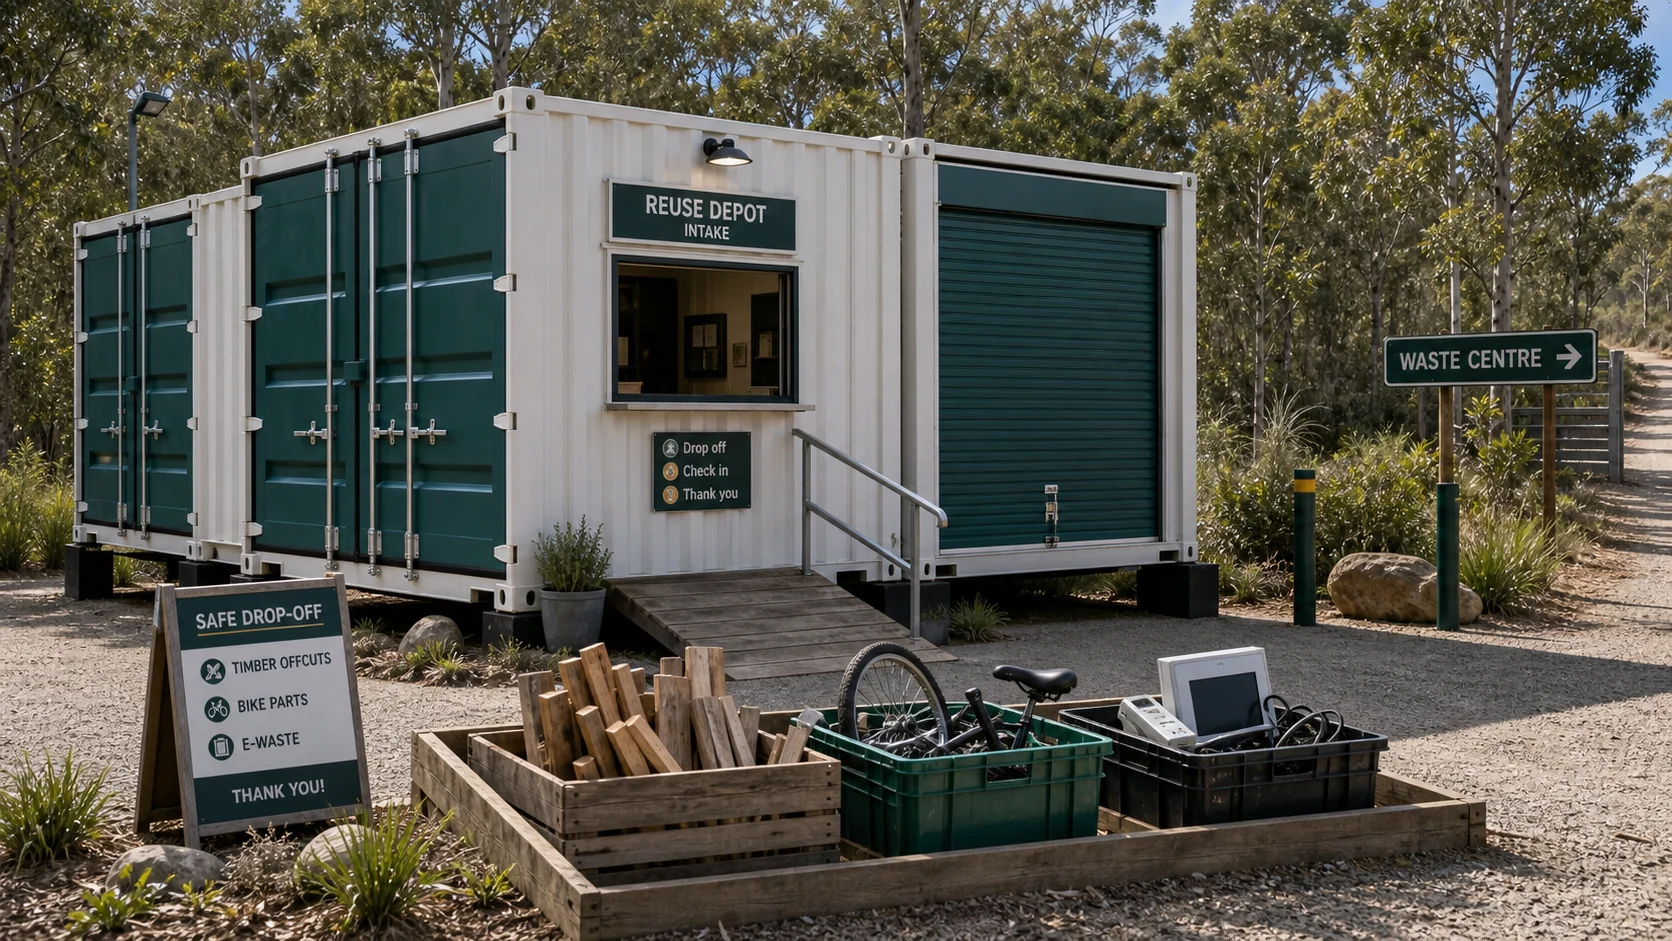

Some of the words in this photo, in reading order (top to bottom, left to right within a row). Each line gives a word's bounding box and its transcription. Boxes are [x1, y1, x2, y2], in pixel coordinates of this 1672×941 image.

[646, 194, 703, 218] REUSE
[709, 200, 767, 223] DEPOT
[684, 223, 730, 240] INTAKE
[1400, 351, 1461, 371] WASTE
[1467, 348, 1542, 369] CENTRE
[683, 442, 708, 456] Drop
[711, 441, 727, 453] off
[683, 464, 716, 477] Check
[719, 464, 728, 476] in
[683, 487, 716, 500] Thank
[719, 489, 738, 502] you
[195, 610, 237, 630] SAFE
[242, 603, 322, 626] DROP-OFF
[231, 657, 277, 675] TIMBER
[280, 652, 332, 669] OFFCUTS
[237, 697, 266, 713] BIKE
[269, 693, 308, 710] PARTS
[242, 732, 300, 751] E-WASTE
[231, 784, 285, 804] THANK
[288, 779, 325, 798] YOU!
